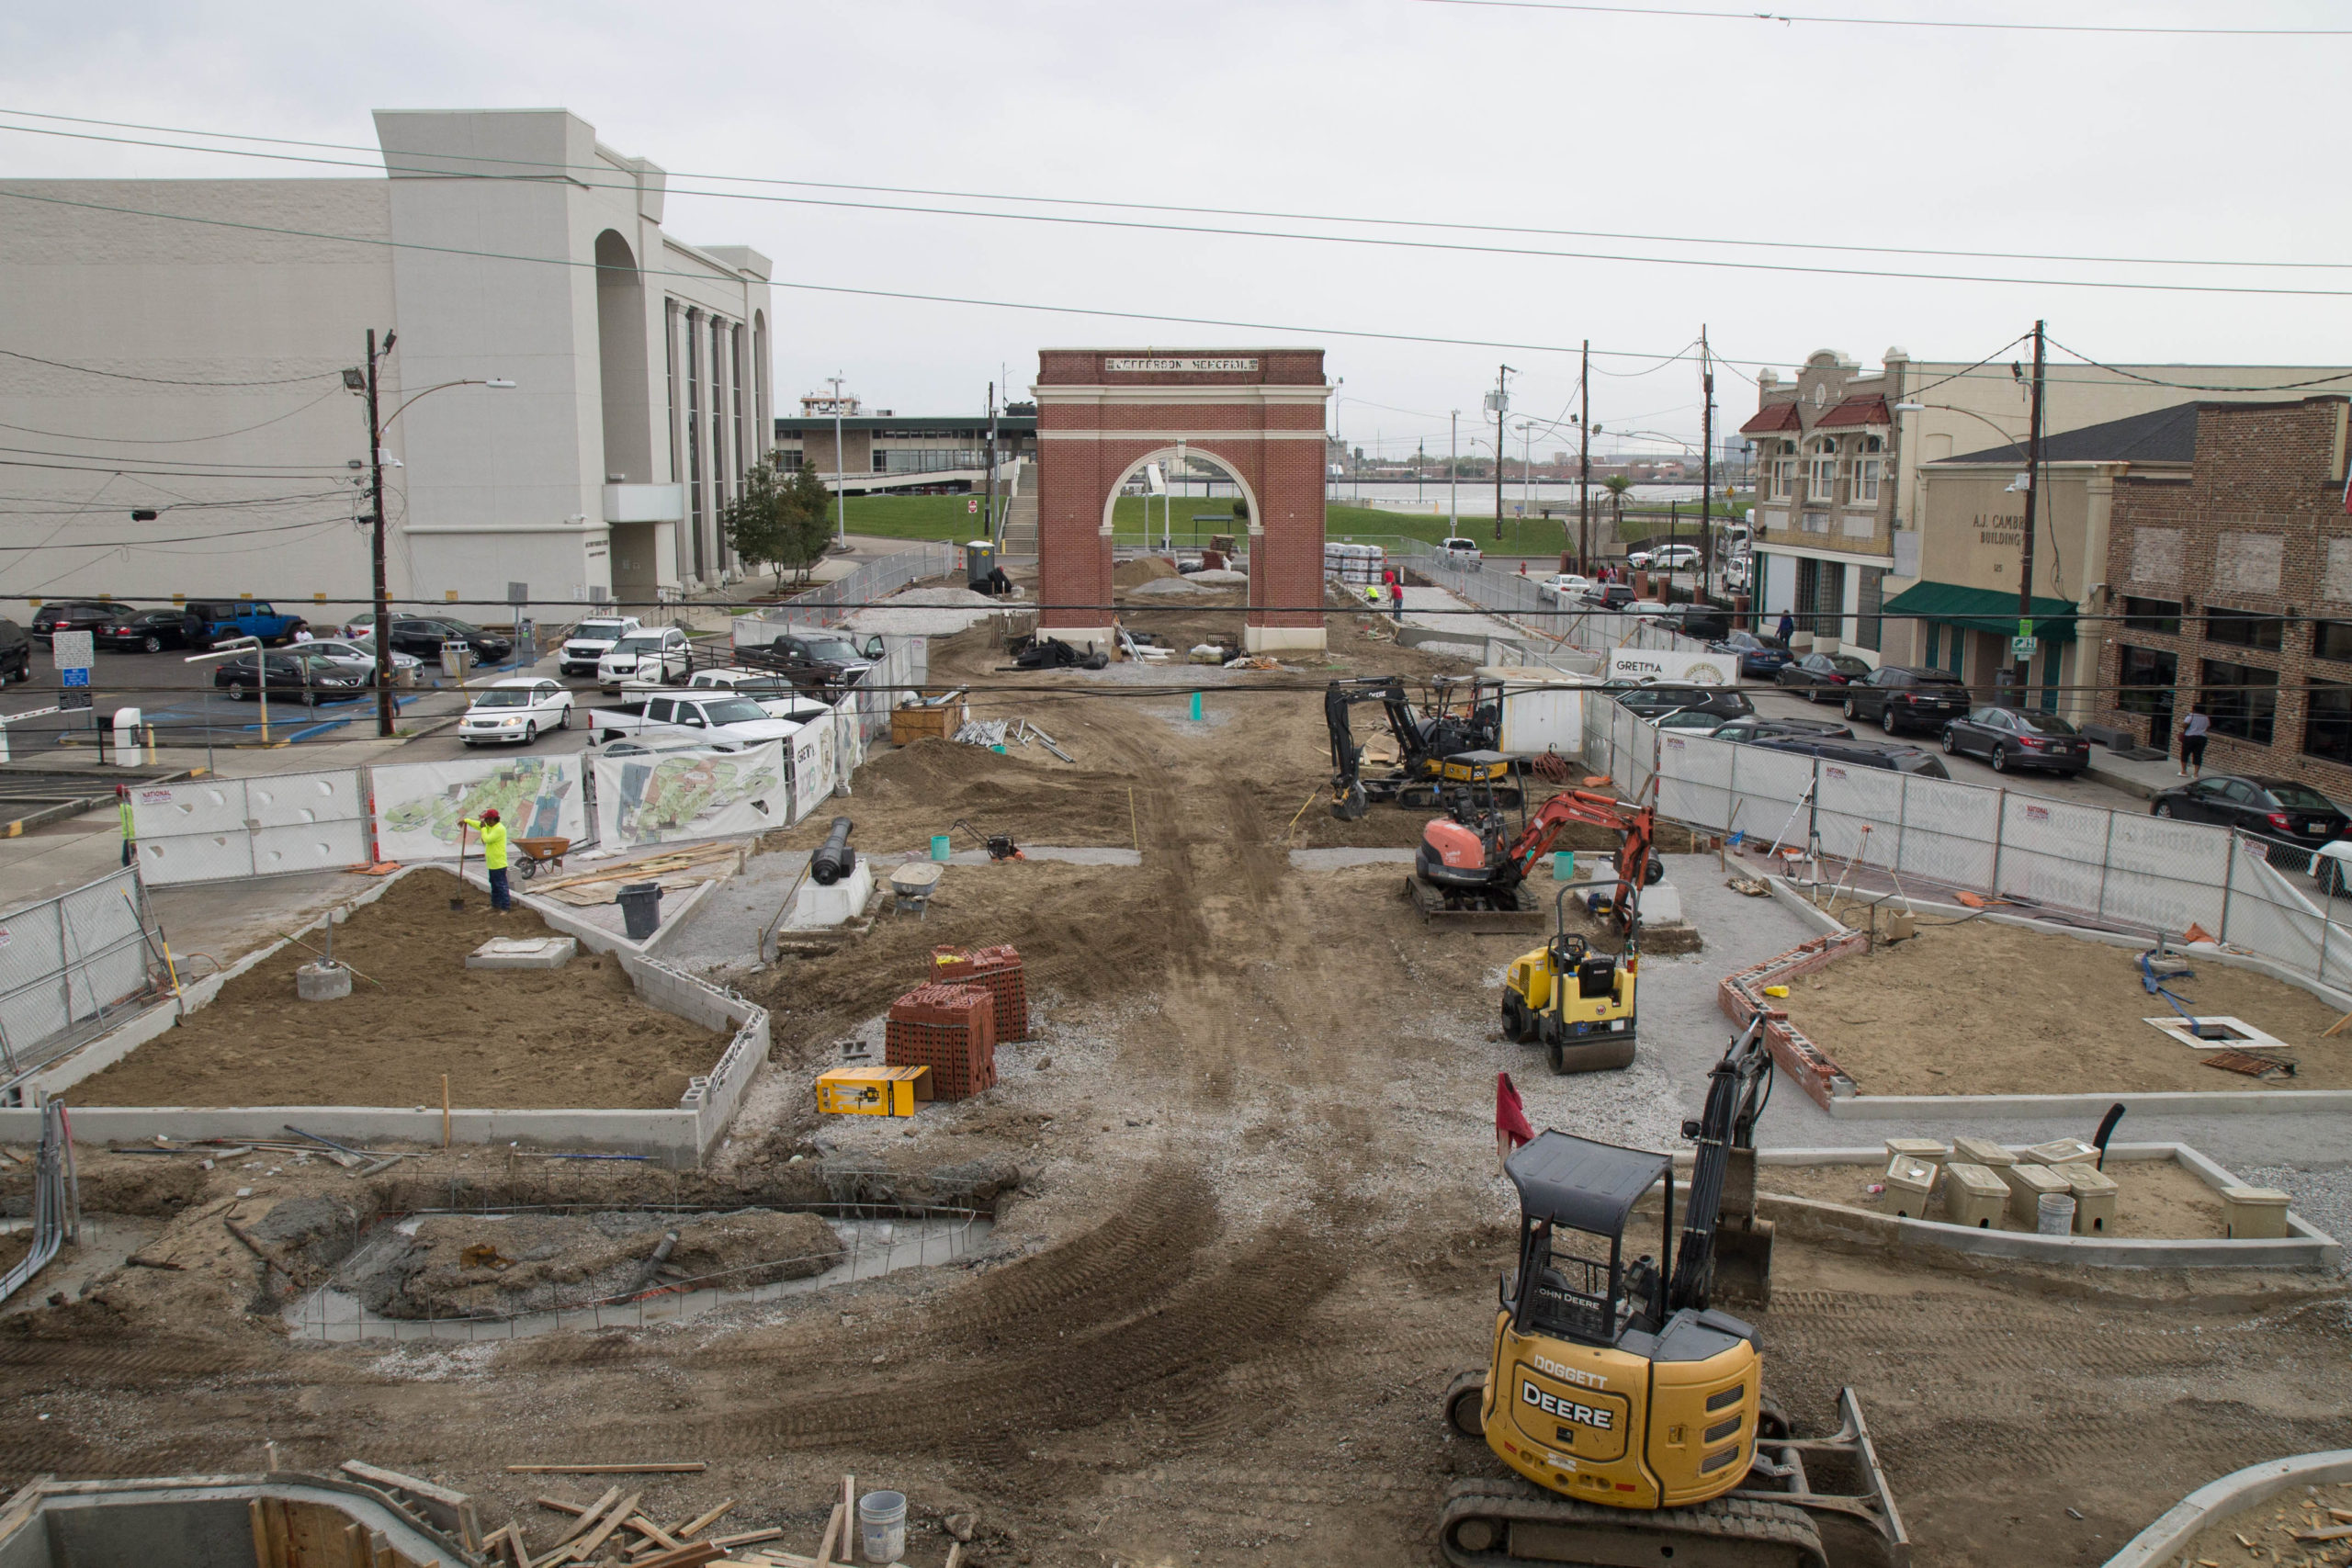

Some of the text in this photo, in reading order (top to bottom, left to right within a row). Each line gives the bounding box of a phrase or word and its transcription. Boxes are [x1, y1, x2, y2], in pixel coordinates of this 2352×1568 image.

[1115, 359, 1247, 369] JEFFERSON MEMORIAL
[1973, 514, 2026, 530] A.J. CAMBR
[1980, 532, 2021, 546] BUILDING
[1537, 1288, 1600, 1310] OHN DEERE
[1534, 1354, 1608, 1390] DOGGETT
[1521, 1380, 1612, 1430] DEERE
